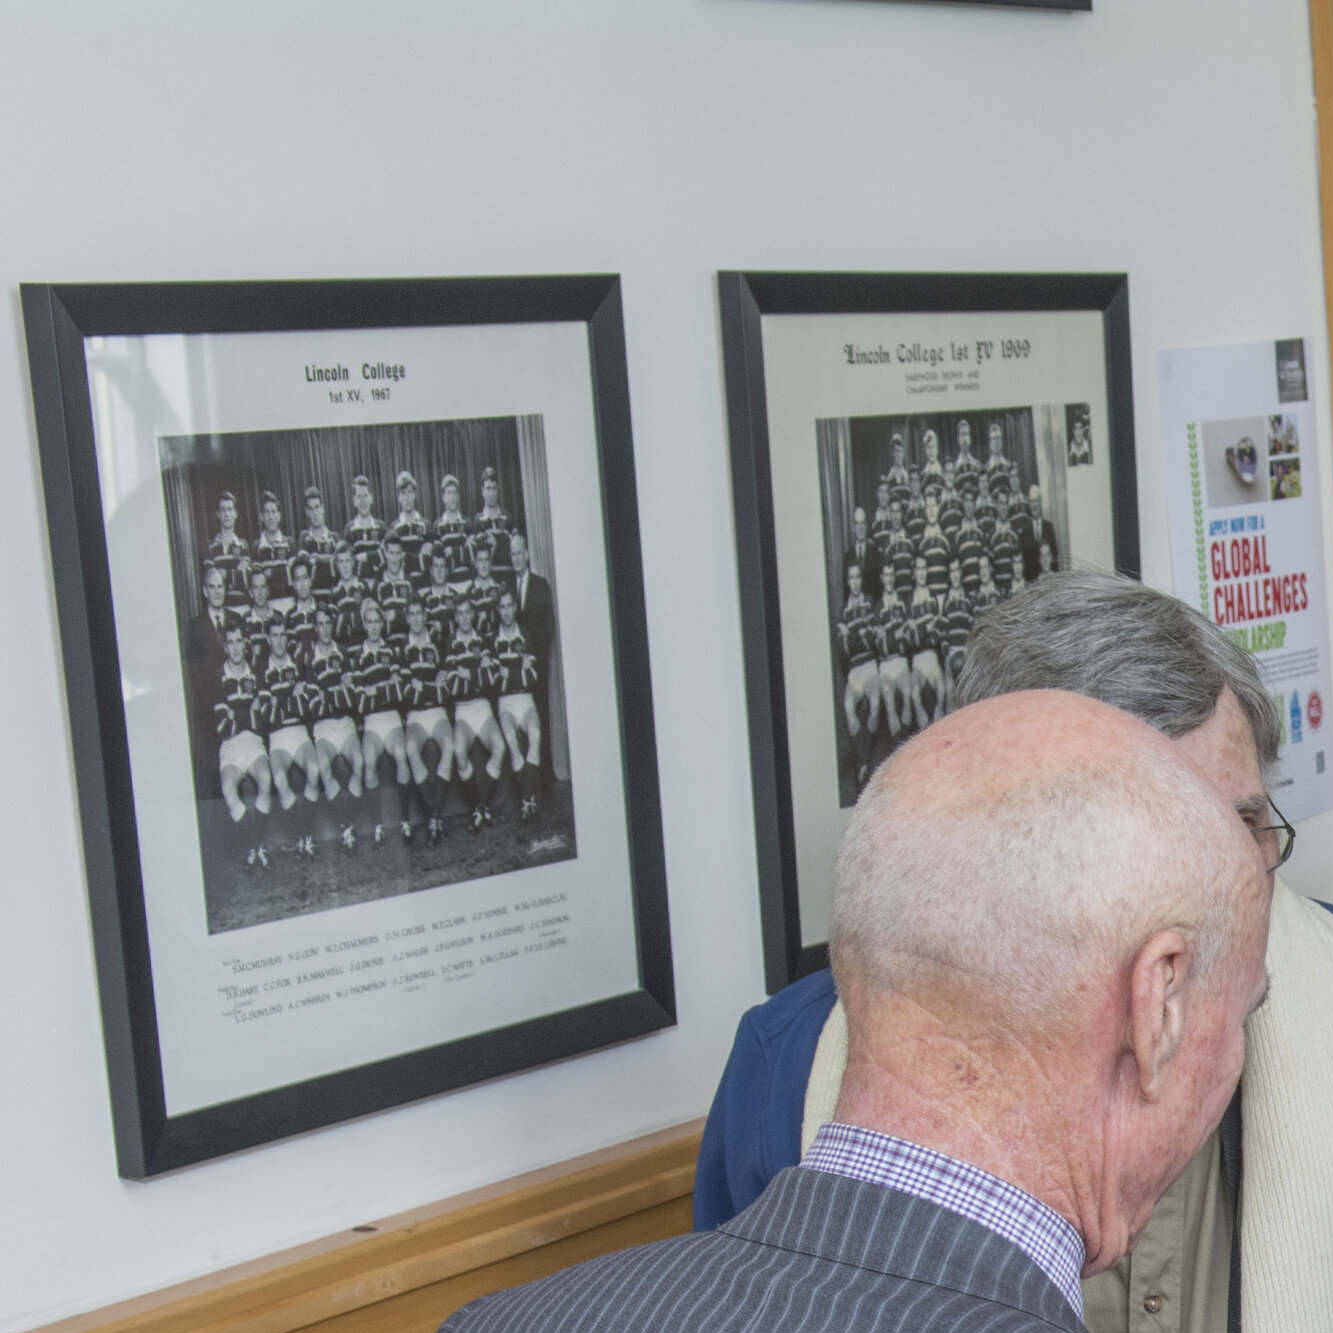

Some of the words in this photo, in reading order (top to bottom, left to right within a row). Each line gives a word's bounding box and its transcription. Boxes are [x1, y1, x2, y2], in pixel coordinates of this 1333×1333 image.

[843, 343, 891, 366] Lincoln
[897, 343, 944, 367] College
[951, 342, 968, 361] 1st
[976, 340, 994, 365] XV
[1001, 339, 1031, 359] 1969
[305, 364, 349, 382] Lincoln
[362, 362, 405, 382] College
[329, 391, 343, 403] 1st
[346, 389, 364, 404] XV,
[371, 387, 390, 401] 1967
[1209, 520, 1228, 536] APPLY
[1230, 518, 1245, 533] NOW
[1247, 515, 1259, 531] FOR
[1211, 535, 1270, 581] GLOBAL
[1214, 572, 1308, 626] CHALLENGES
